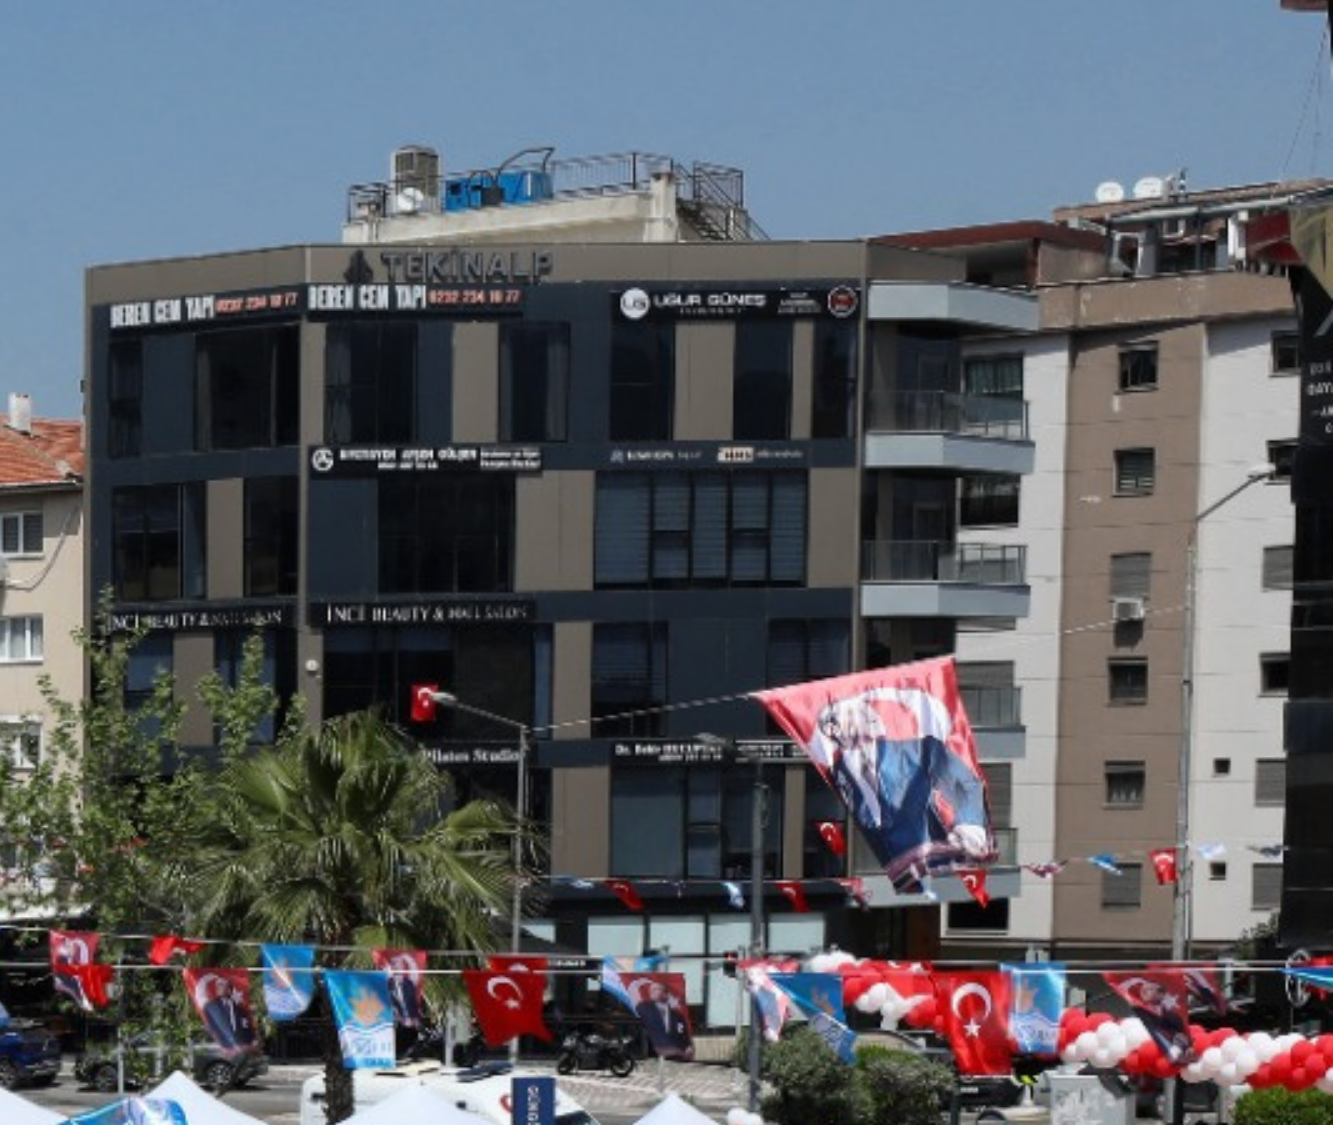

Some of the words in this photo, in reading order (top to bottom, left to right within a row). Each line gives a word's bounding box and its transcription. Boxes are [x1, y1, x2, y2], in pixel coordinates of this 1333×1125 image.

[380, 245, 555, 283] TEKİNALP
[358, 284, 389, 310] CEM
[653, 292, 702, 307] UĞUR
